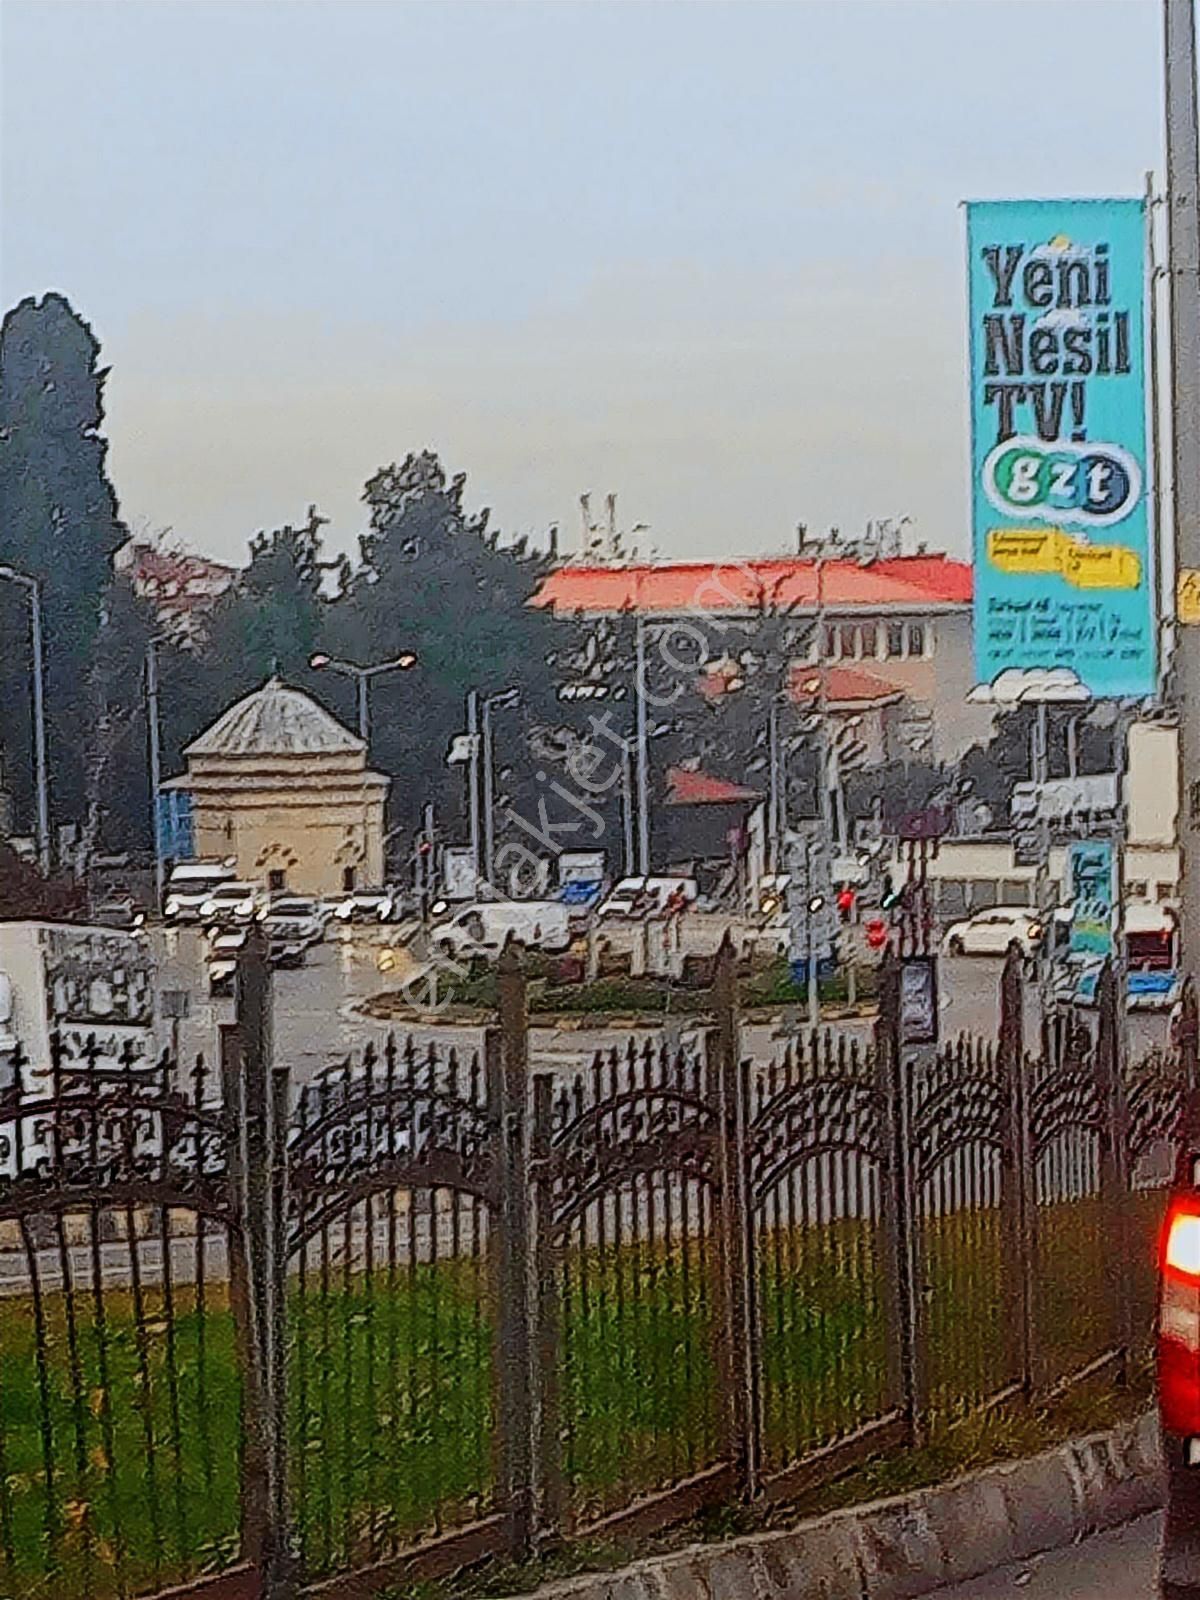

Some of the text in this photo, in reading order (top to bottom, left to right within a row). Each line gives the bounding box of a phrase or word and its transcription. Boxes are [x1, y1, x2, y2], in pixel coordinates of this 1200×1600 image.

[982, 243, 1112, 308] Yeni
[983, 310, 1131, 375] Nesil
[983, 381, 1087, 442] TV!
[1006, 456, 1116, 504] gzt
